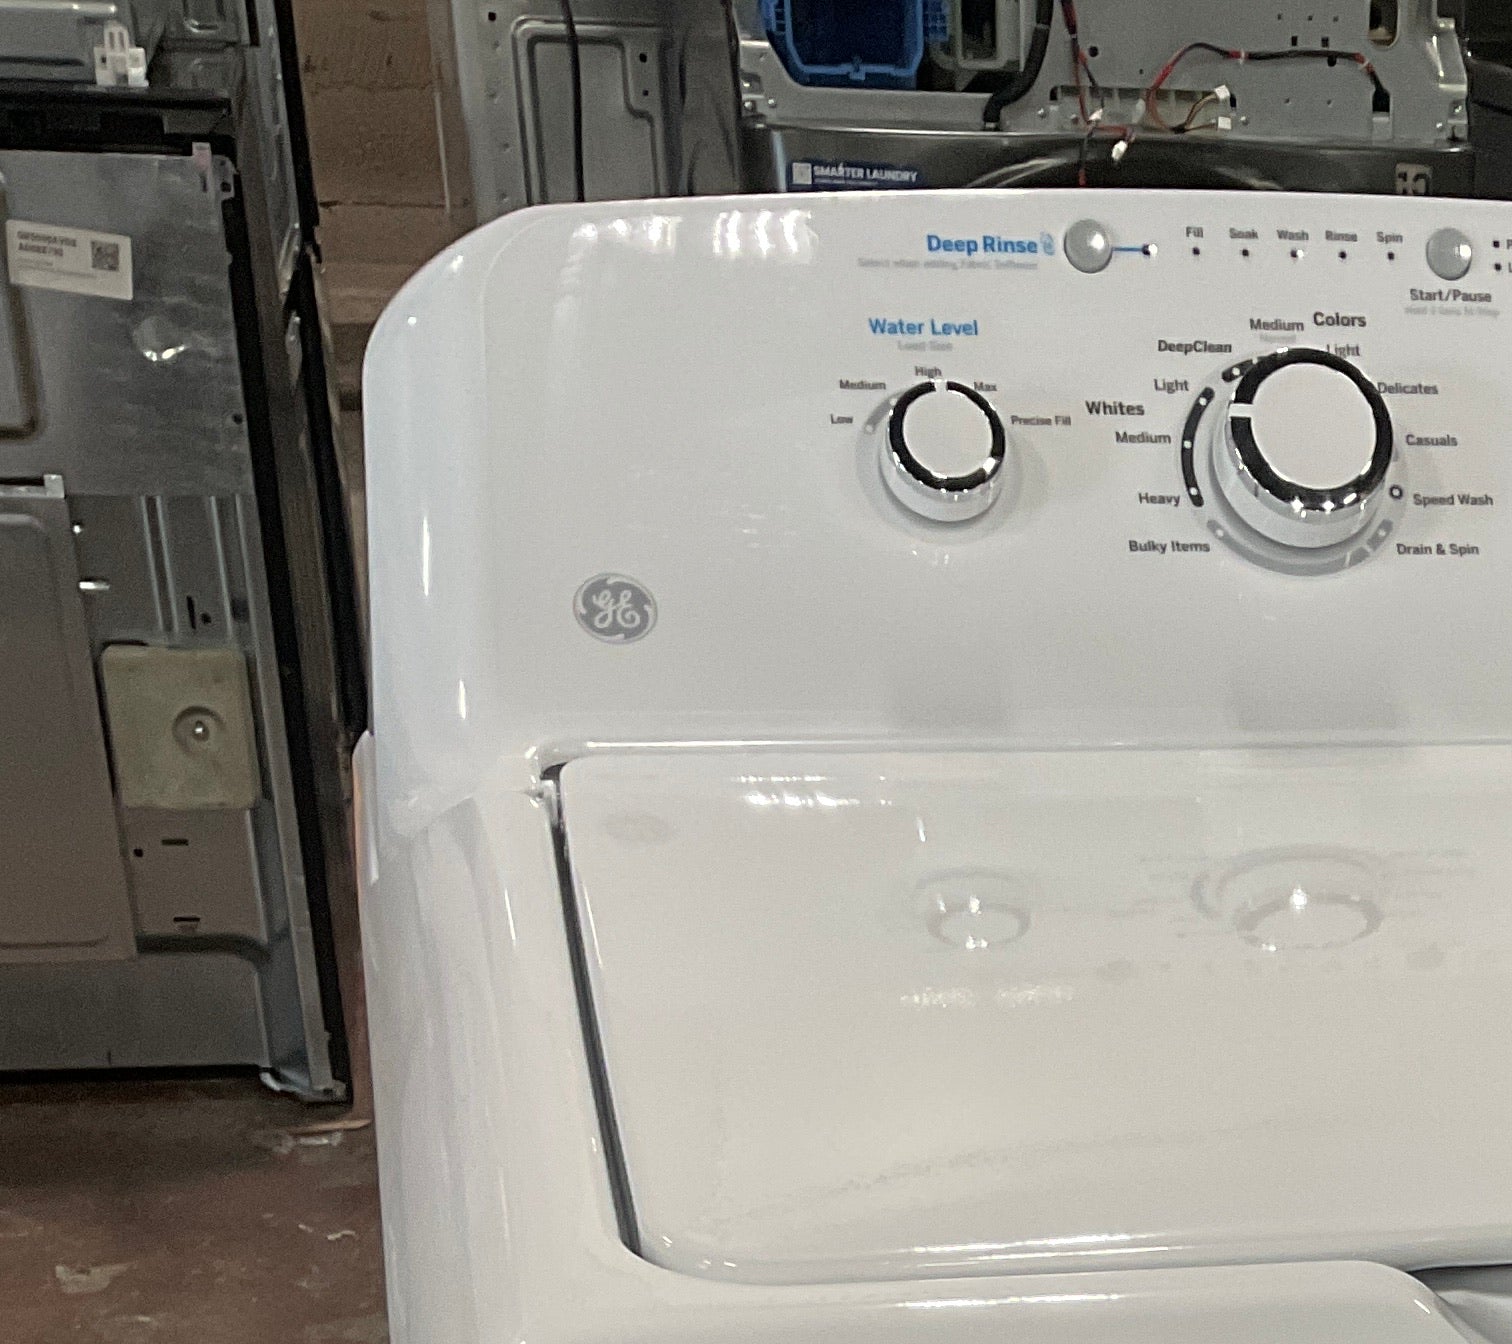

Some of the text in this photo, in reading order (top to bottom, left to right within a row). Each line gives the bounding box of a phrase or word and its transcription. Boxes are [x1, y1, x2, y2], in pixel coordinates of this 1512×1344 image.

[813, 164, 865, 179] SMARTER
[866, 167, 918, 183] LAUNDRY
[1185, 226, 1404, 244] Fill Soak Wash Rinse Spin
[926, 234, 1038, 256] Deep Rinse
[1409, 288, 1493, 303] Start/Pause
[868, 317, 979, 337] Water Level
[1250, 318, 1305, 332] Medium
[1313, 311, 1367, 328] Colors
[1157, 339, 1233, 354] DeepClean
[1327, 344, 1361, 357] Light
[914, 365, 942, 378] High
[839, 379, 887, 391] Medium
[973, 381, 998, 392] Max
[1153, 378, 1189, 394] Light
[1376, 381, 1439, 395] Delicates
[1085, 400, 1146, 417] Whites
[830, 413, 854, 425] Low
[1010, 414, 1072, 426] Precise Fill
[1115, 431, 1172, 445] Medium
[1405, 433, 1459, 447] Casuals
[1138, 492, 1181, 507] Heavy
[1412, 493, 1494, 508] Speed Wash
[1128, 539, 1211, 554] Bulky Items
[1396, 543, 1480, 557] Drain & Spin
